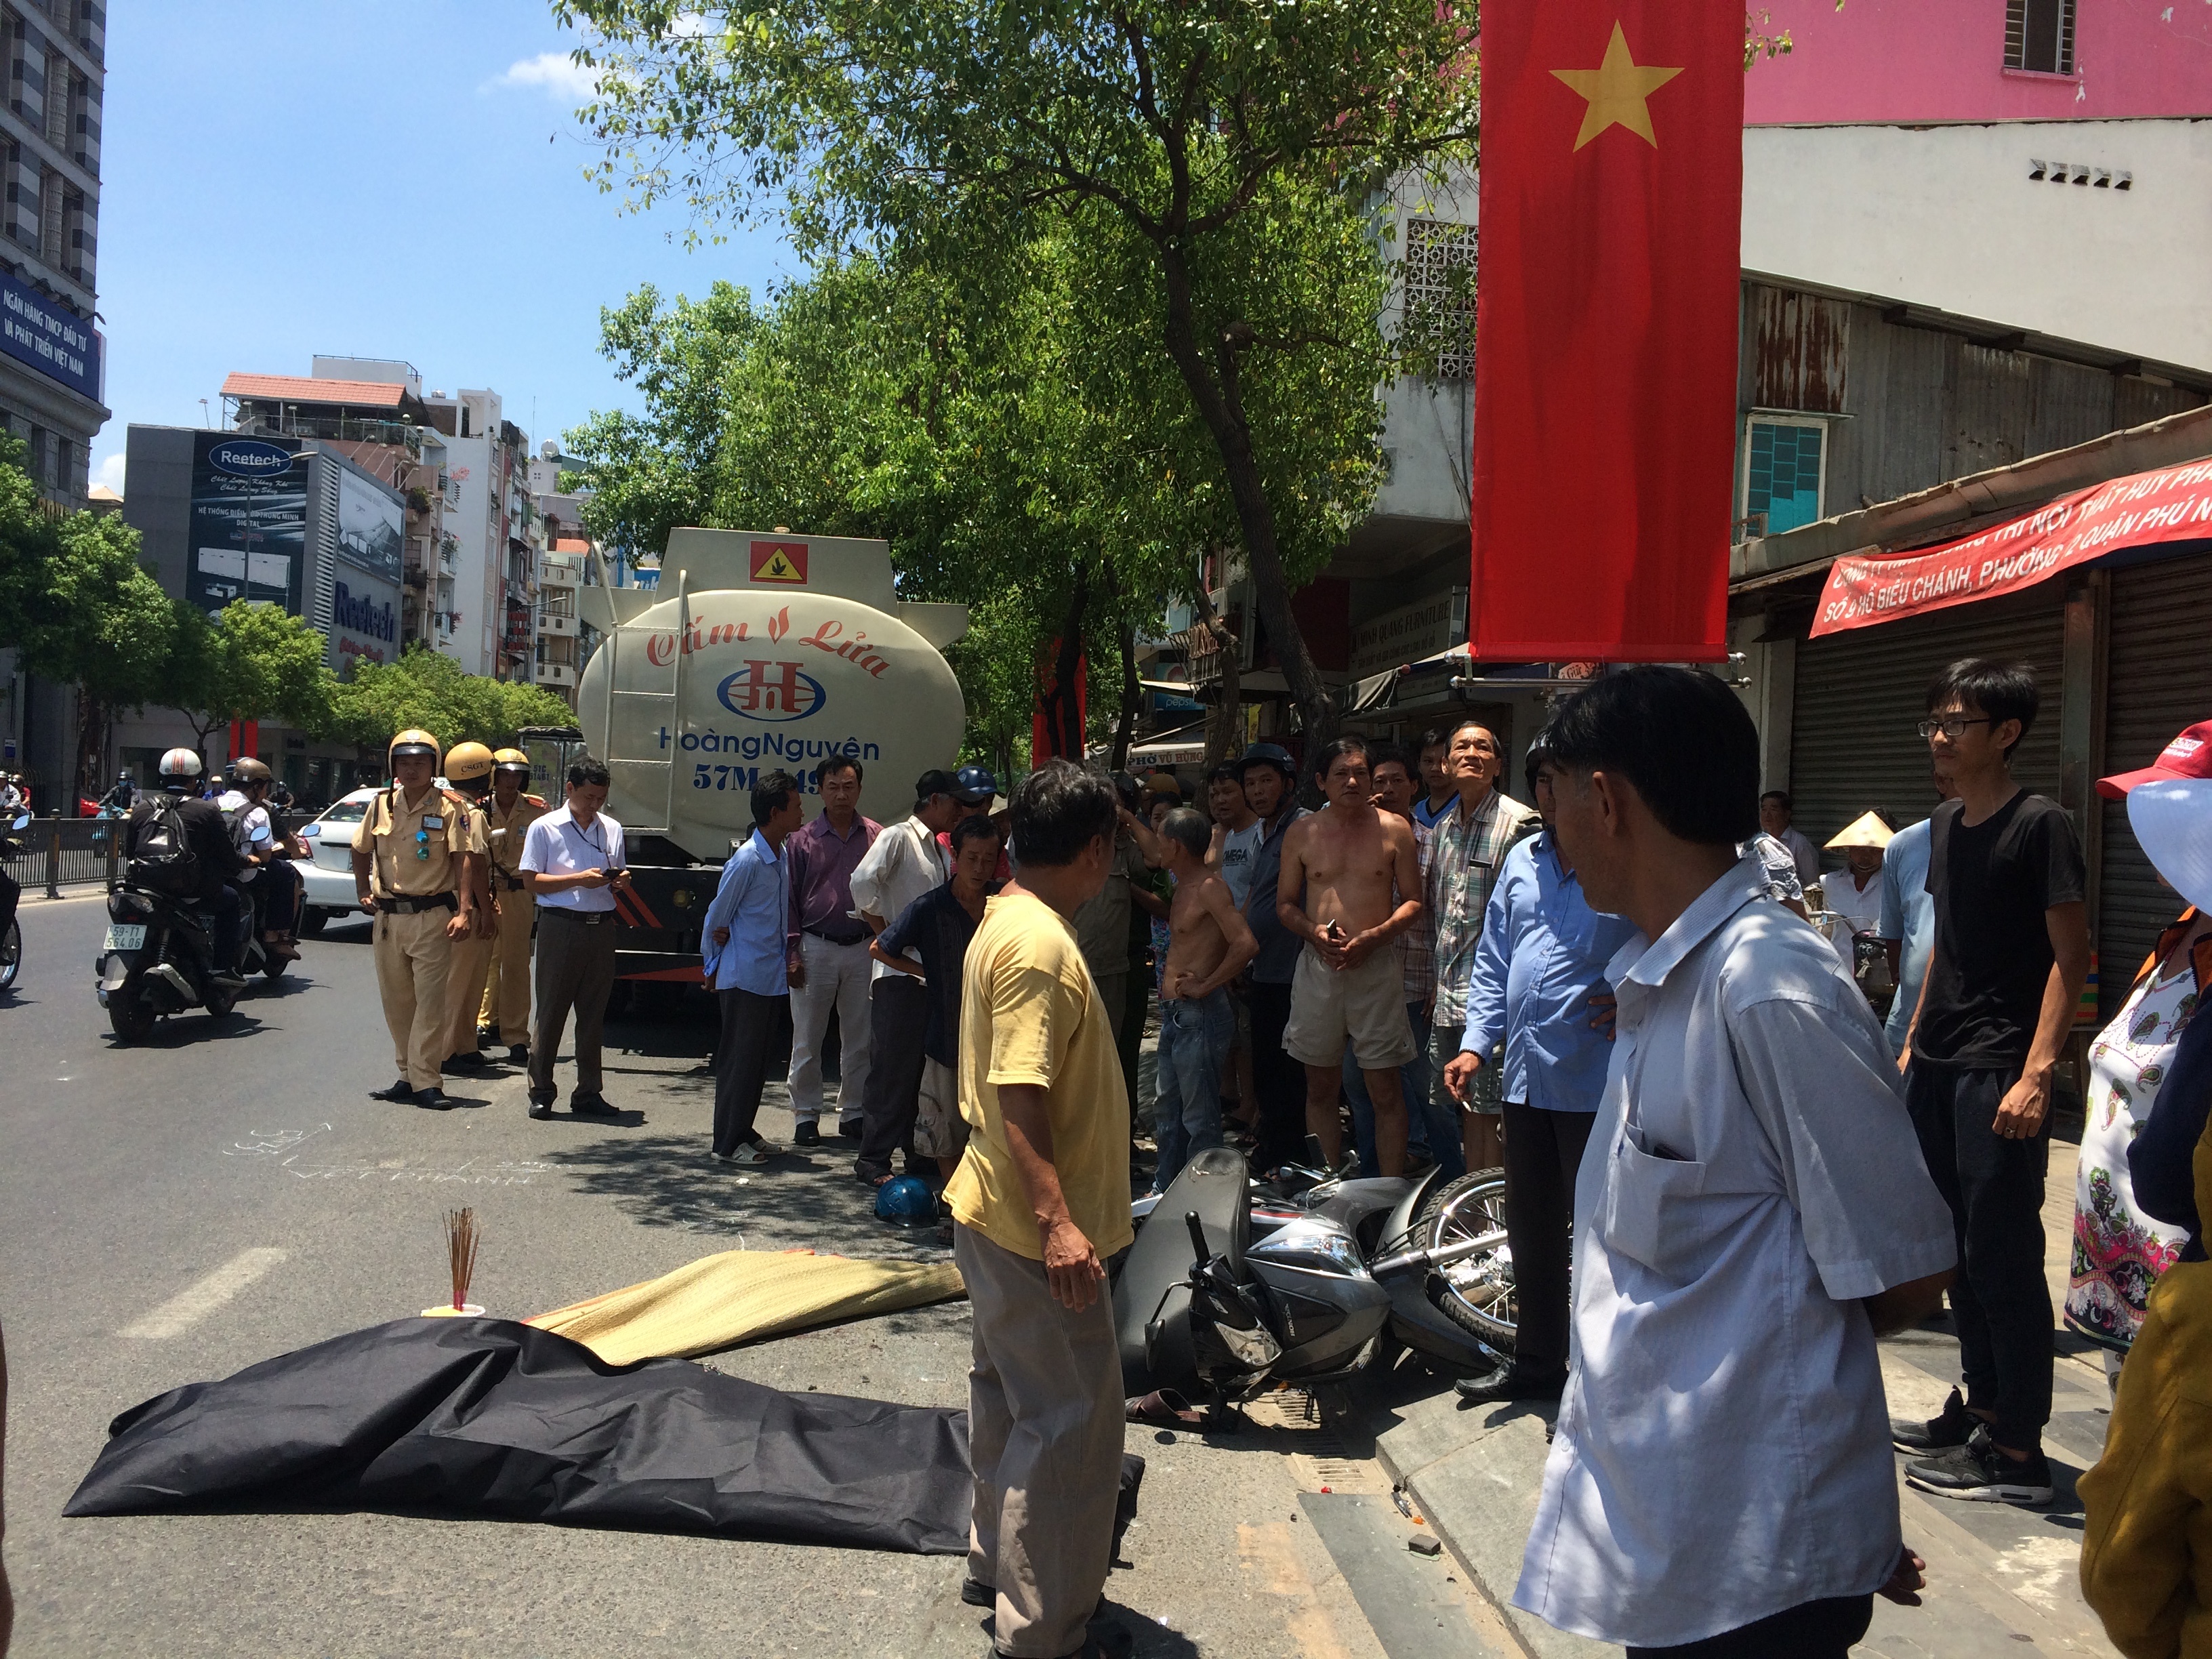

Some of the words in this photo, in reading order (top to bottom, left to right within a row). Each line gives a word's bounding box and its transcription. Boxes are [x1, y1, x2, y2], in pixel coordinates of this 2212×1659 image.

[3, 289, 23, 316] NGÂN
[24, 302, 43, 327] HÀNG
[45, 314, 62, 337] TMCP
[78, 334, 87, 352] TƯ
[4, 316, 14, 337] VÀ
[15, 324, 33, 348] PHÁT
[35, 335, 53, 360] TRIỂN
[54, 347, 68, 369] VIỆT
[68, 355, 83, 377] NAM
[221, 451, 281, 467] Reetech
[207, 507, 229, 516] THỐNG
[282, 513, 300, 521] MINH
[2029, 502, 2072, 537] NỘI
[2076, 481, 2128, 524] THẤT
[2120, 472, 2175, 504] HUY
[236, 519, 260, 527] DIGTAL
[1824, 592, 1851, 623] SỐ
[1856, 583, 1877, 617] HỒ
[1877, 572, 1911, 611] BIỂU
[1912, 565, 1973, 602] CHÁNH,
[1978, 544, 2064, 586] PHƯỜNG
[2064, 533, 2083, 558] 2
[2080, 510, 2142, 550] QUẬN
[2135, 493, 2197, 532] PHÚ
[1406, 600, 1450, 634] FURNITURE
[798, 620, 890, 680] Lửa
[461, 761, 485, 773] CSGT
[1127, 752, 1157, 766] PHỞ
[693, 763, 761, 792] 57M
[113, 926, 140, 937] 59-T1
